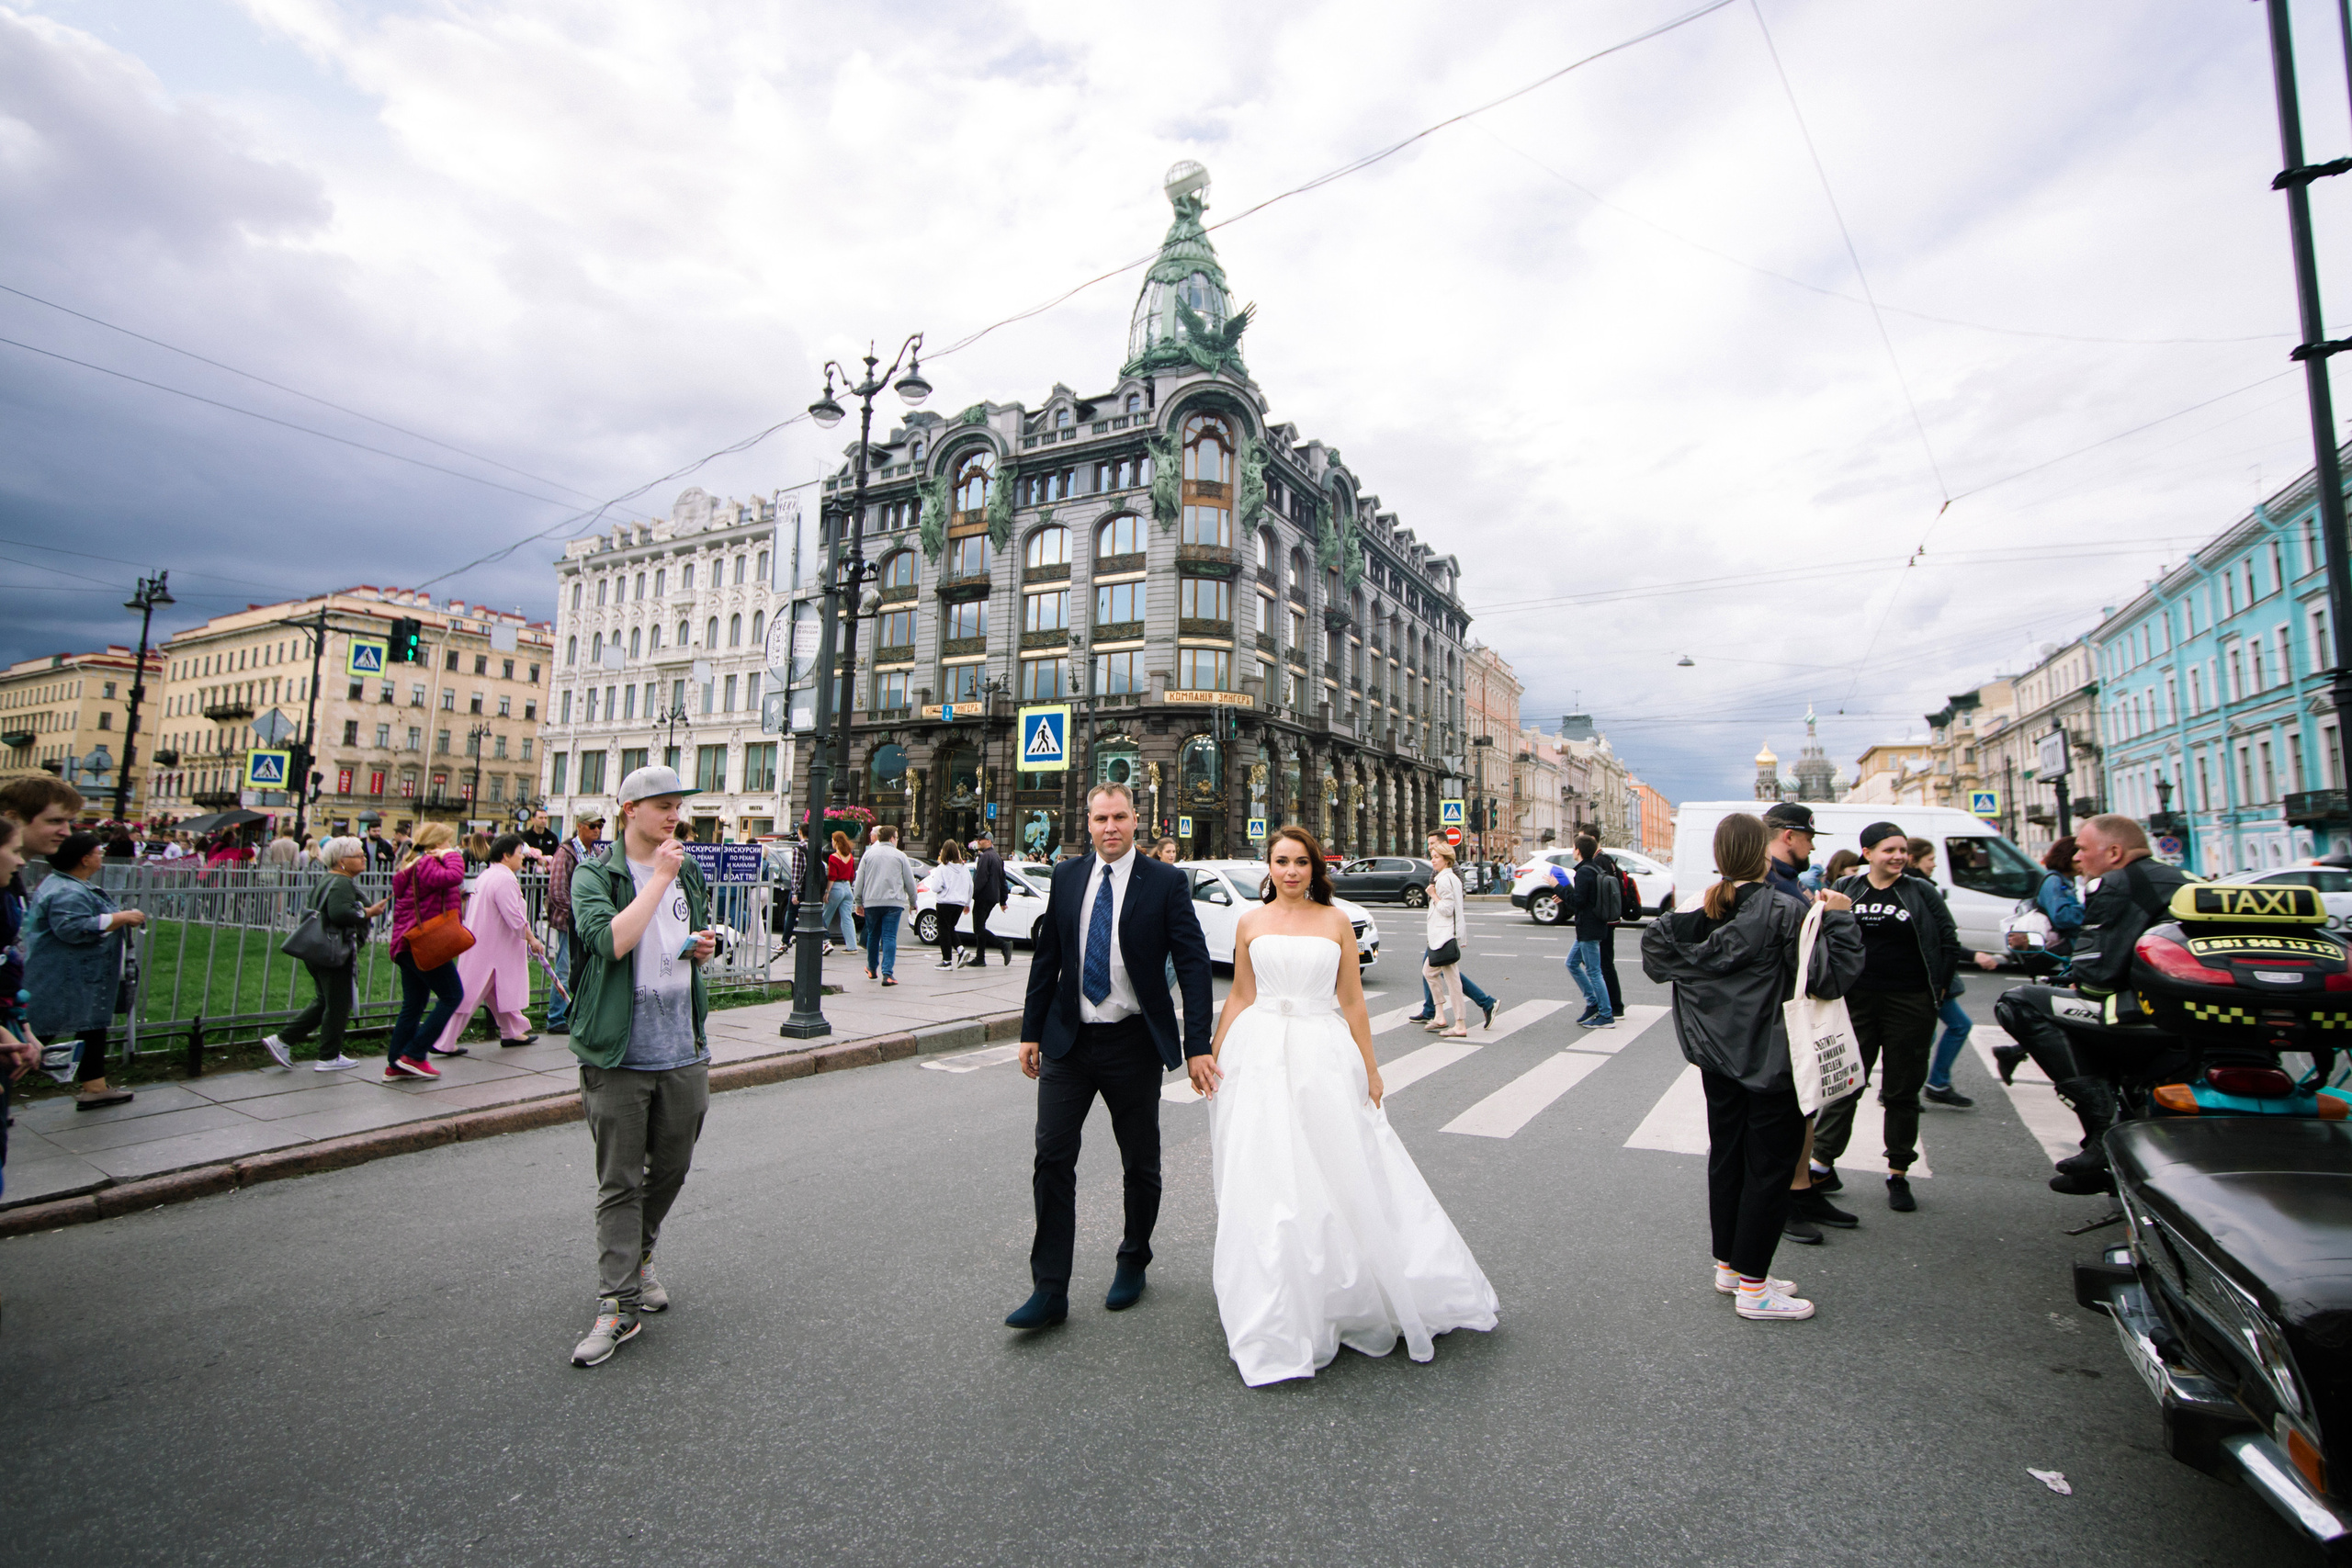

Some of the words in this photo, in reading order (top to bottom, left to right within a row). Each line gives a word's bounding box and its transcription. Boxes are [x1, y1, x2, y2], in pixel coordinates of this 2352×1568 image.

[2211, 889, 2297, 914] TAXI
[1849, 903, 1910, 921] ROSS
[2194, 941, 2208, 951] 8
[2313, 943, 2339, 955] 12
